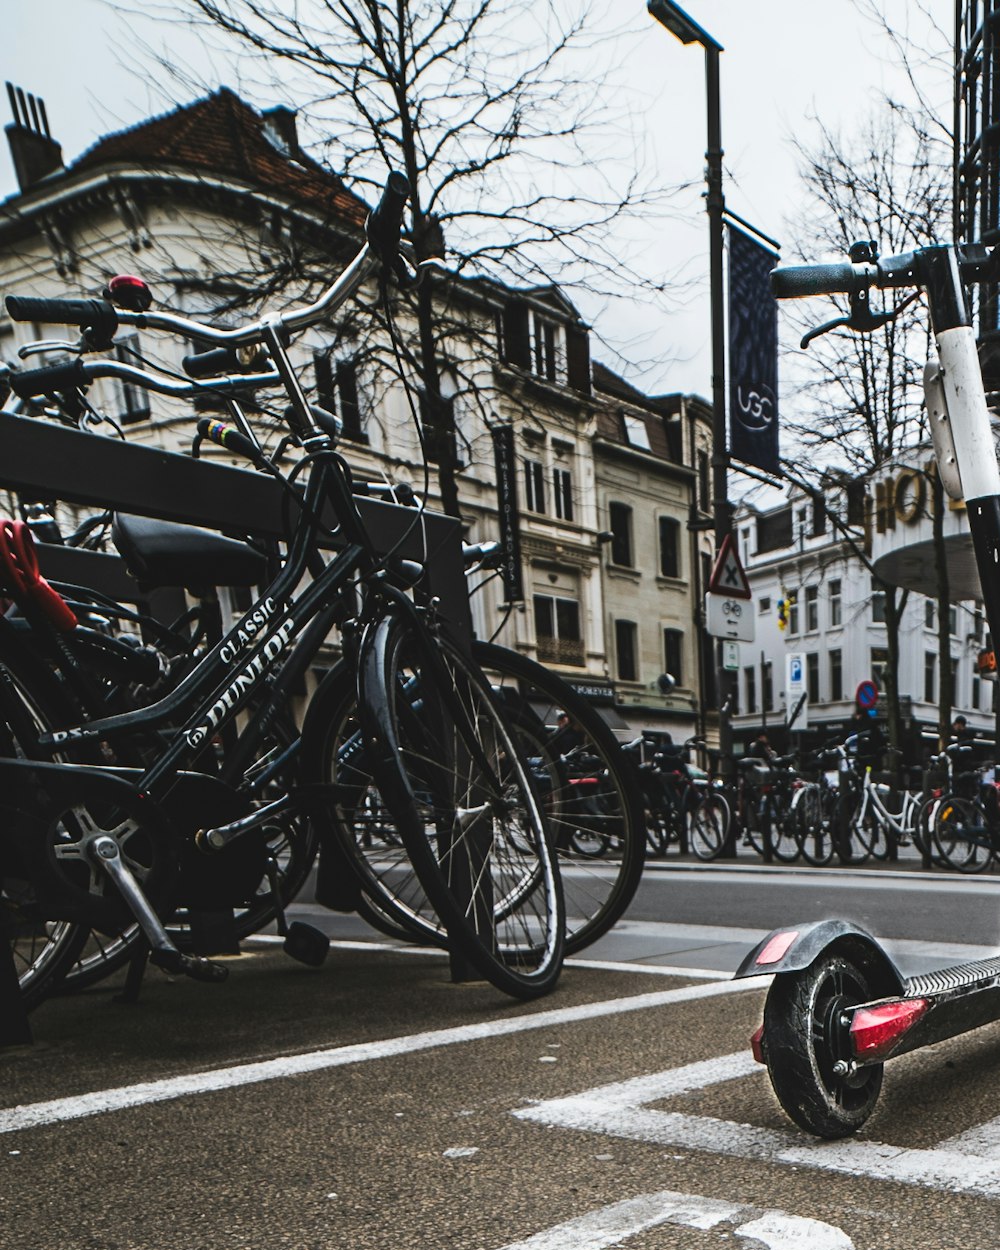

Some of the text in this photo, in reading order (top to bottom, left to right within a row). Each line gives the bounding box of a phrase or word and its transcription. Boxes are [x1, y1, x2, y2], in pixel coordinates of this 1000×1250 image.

[737, 384, 773, 423] UGC
[218, 596, 278, 665] CLASSIC
[205, 617, 295, 728] DUNLOP
[576, 684, 614, 697] FOREVER
